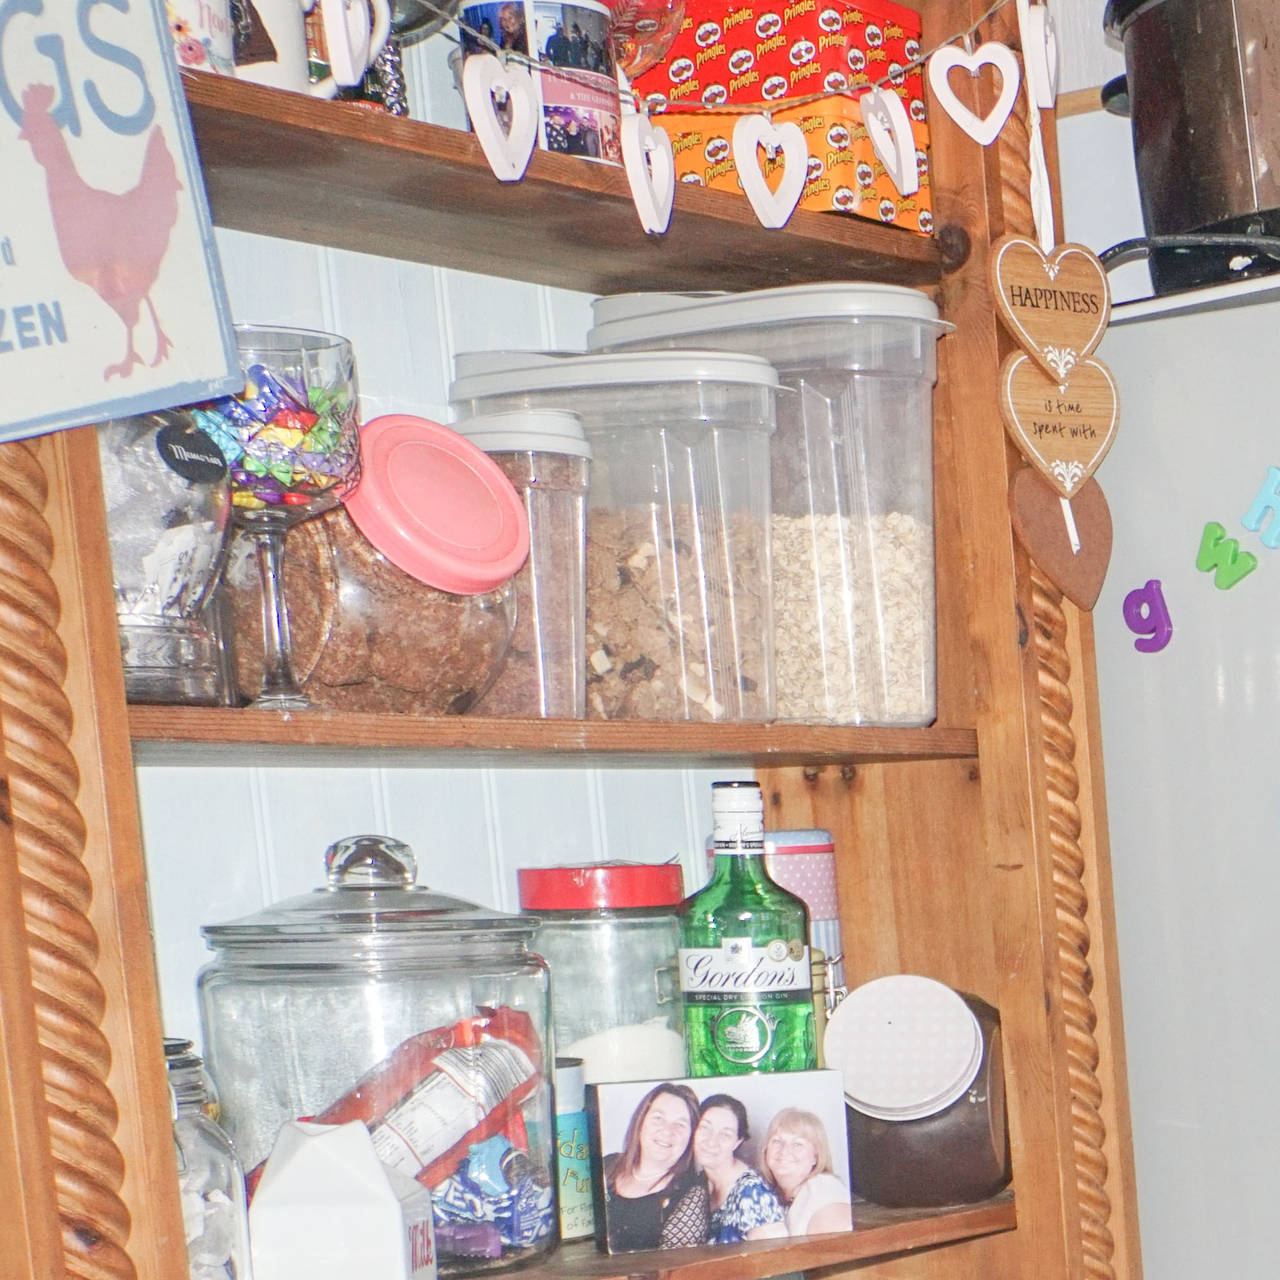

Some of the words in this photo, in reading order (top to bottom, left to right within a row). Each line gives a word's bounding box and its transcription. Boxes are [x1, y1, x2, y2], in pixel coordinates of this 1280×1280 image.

[723, 8, 754, 35] Pringles
[696, 43, 726, 70] Pringles
[756, 34, 787, 62] Pringles
[729, 70, 760, 98] Pringles
[790, 60, 822, 89] Pringles
[670, 79, 700, 101] Pringles
[672, 131, 703, 161] Pringles
[1010, 285, 1099, 315] HAPPINESS
[1044, 400, 1053, 414] is
[1057, 400, 1082, 414] time
[1033, 421, 1067, 440] spent
[1069, 422, 1097, 439] with
[686, 954, 798, 989] Gordon's
